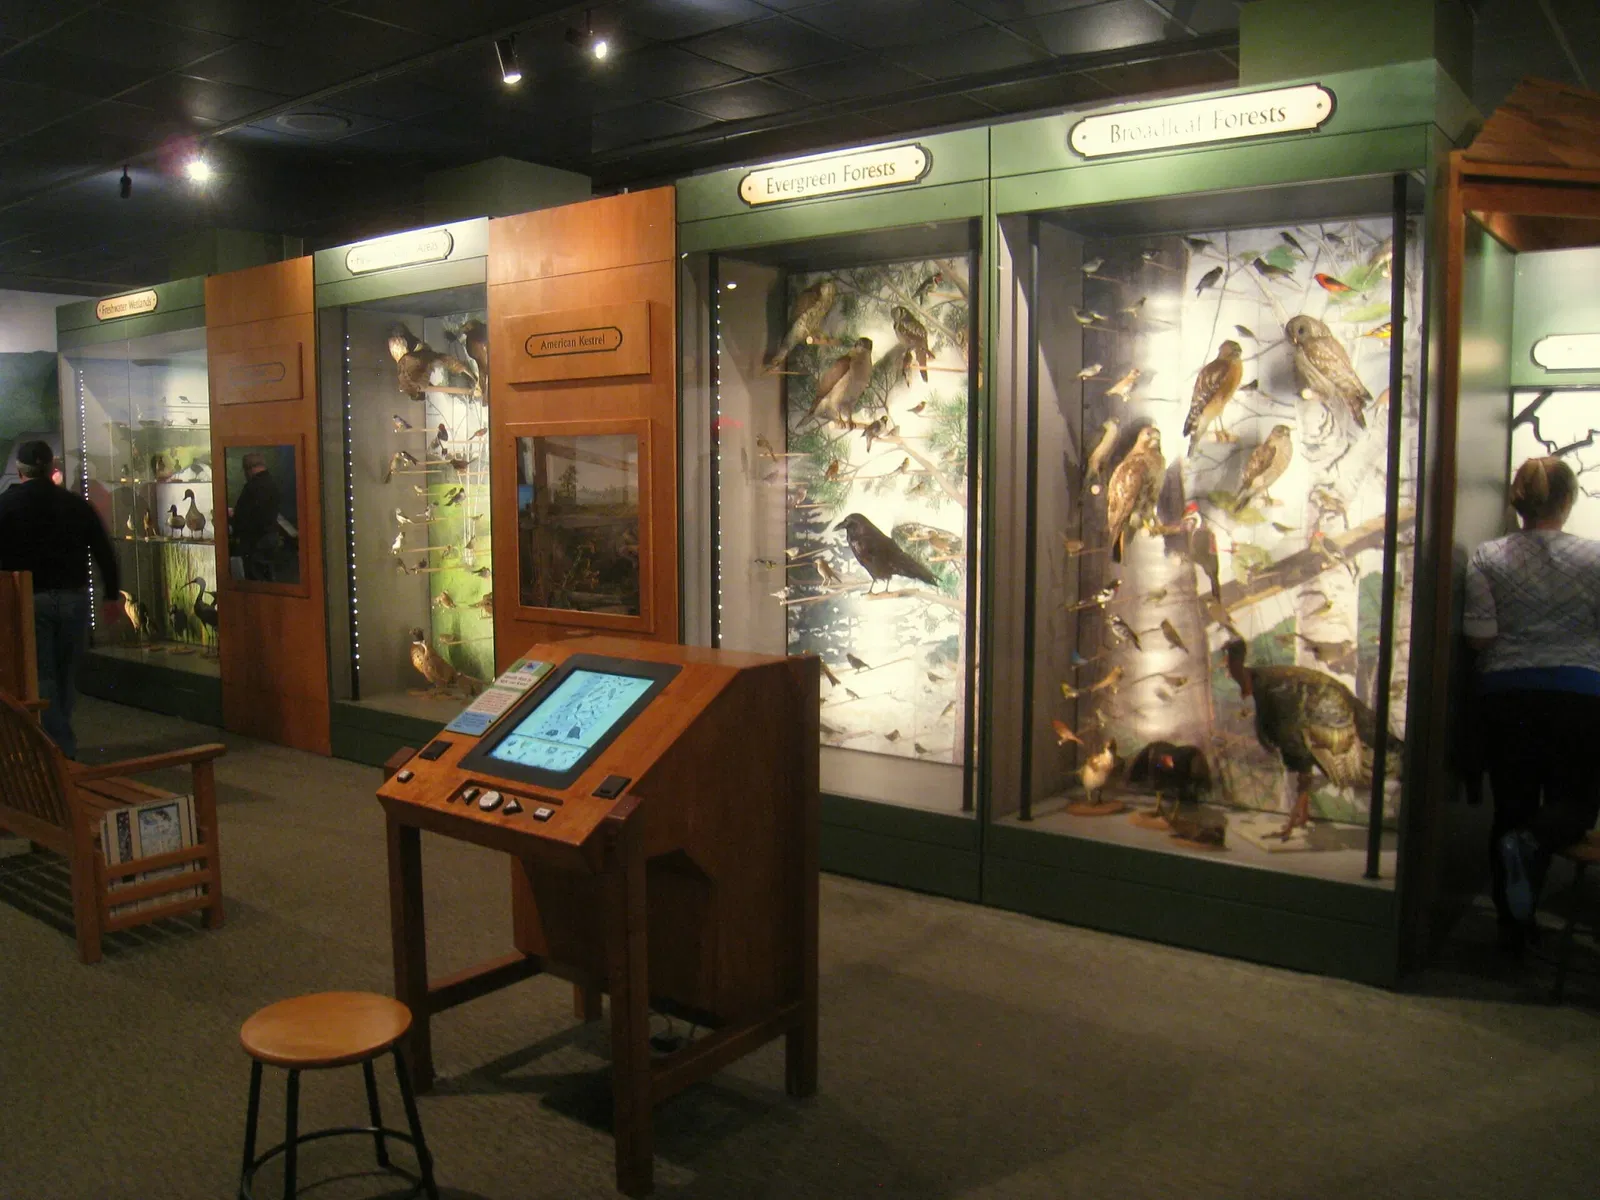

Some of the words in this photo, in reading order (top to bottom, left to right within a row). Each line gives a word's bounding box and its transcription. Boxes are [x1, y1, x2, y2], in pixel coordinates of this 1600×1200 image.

[1110, 116, 1202, 143] Broadleaf
[1214, 105, 1287, 129] Forests
[766, 170, 836, 194] Evergreen
[843, 161, 896, 182] Forests
[102, 303, 127, 315] Freshwater
[128, 296, 152, 309] Wetlands
[540, 337, 577, 350] American
[579, 333, 605, 346] Kestrel
